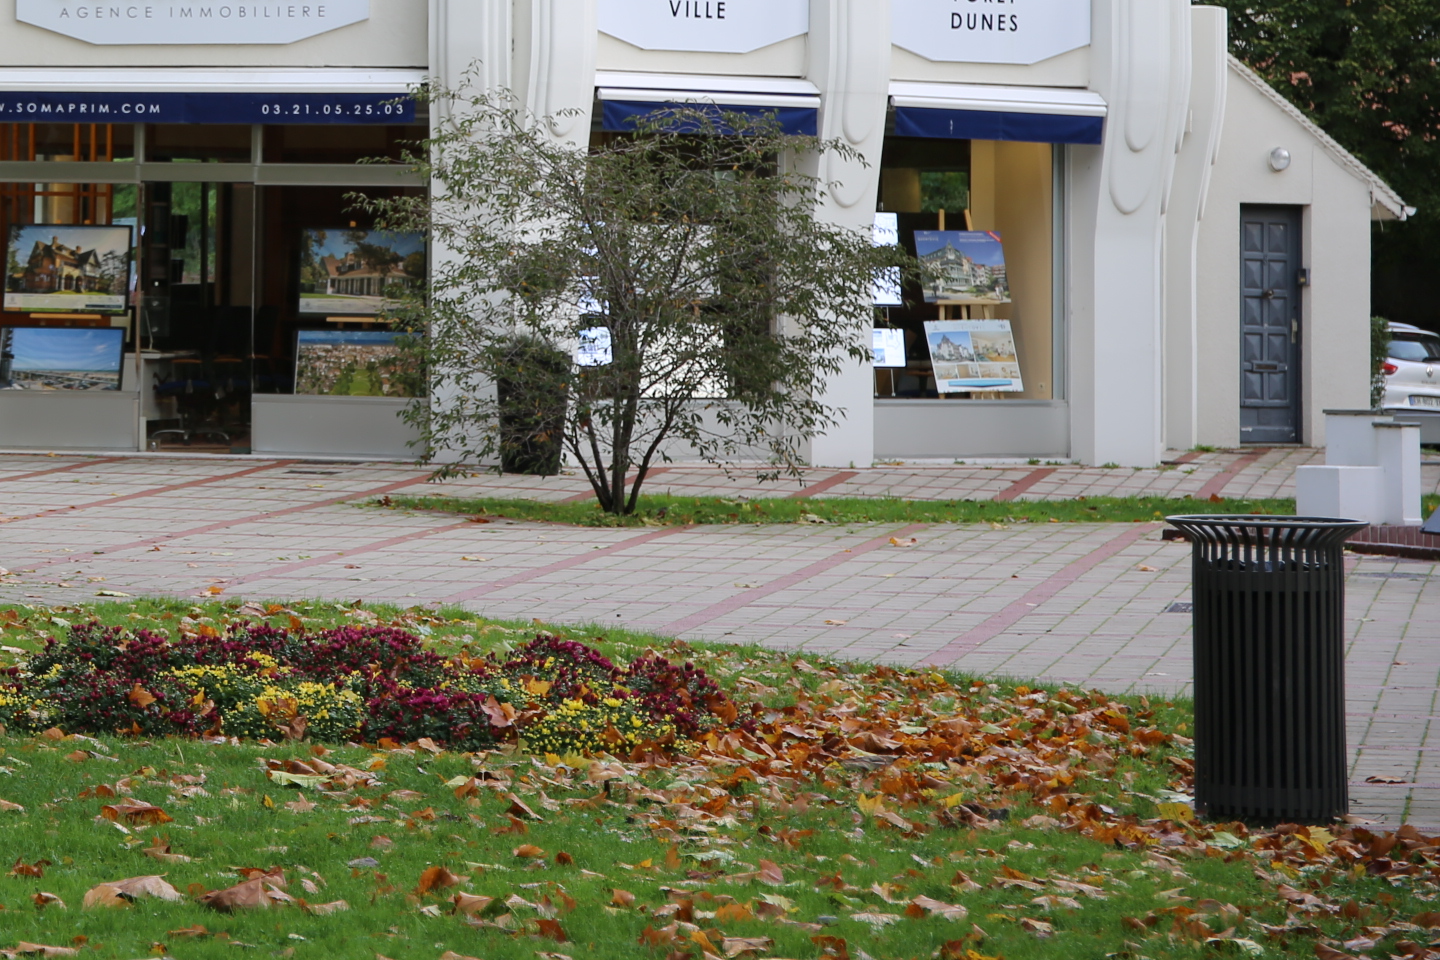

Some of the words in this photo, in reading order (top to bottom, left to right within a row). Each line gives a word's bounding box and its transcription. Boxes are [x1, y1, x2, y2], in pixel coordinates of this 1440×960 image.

[59, 6, 153, 19] AGENCE
[169, 5, 326, 19] IMMOBILIERE
[951, 12, 1018, 32] DUNES
[261, 103, 404, 115] 03.21.05.25.03
